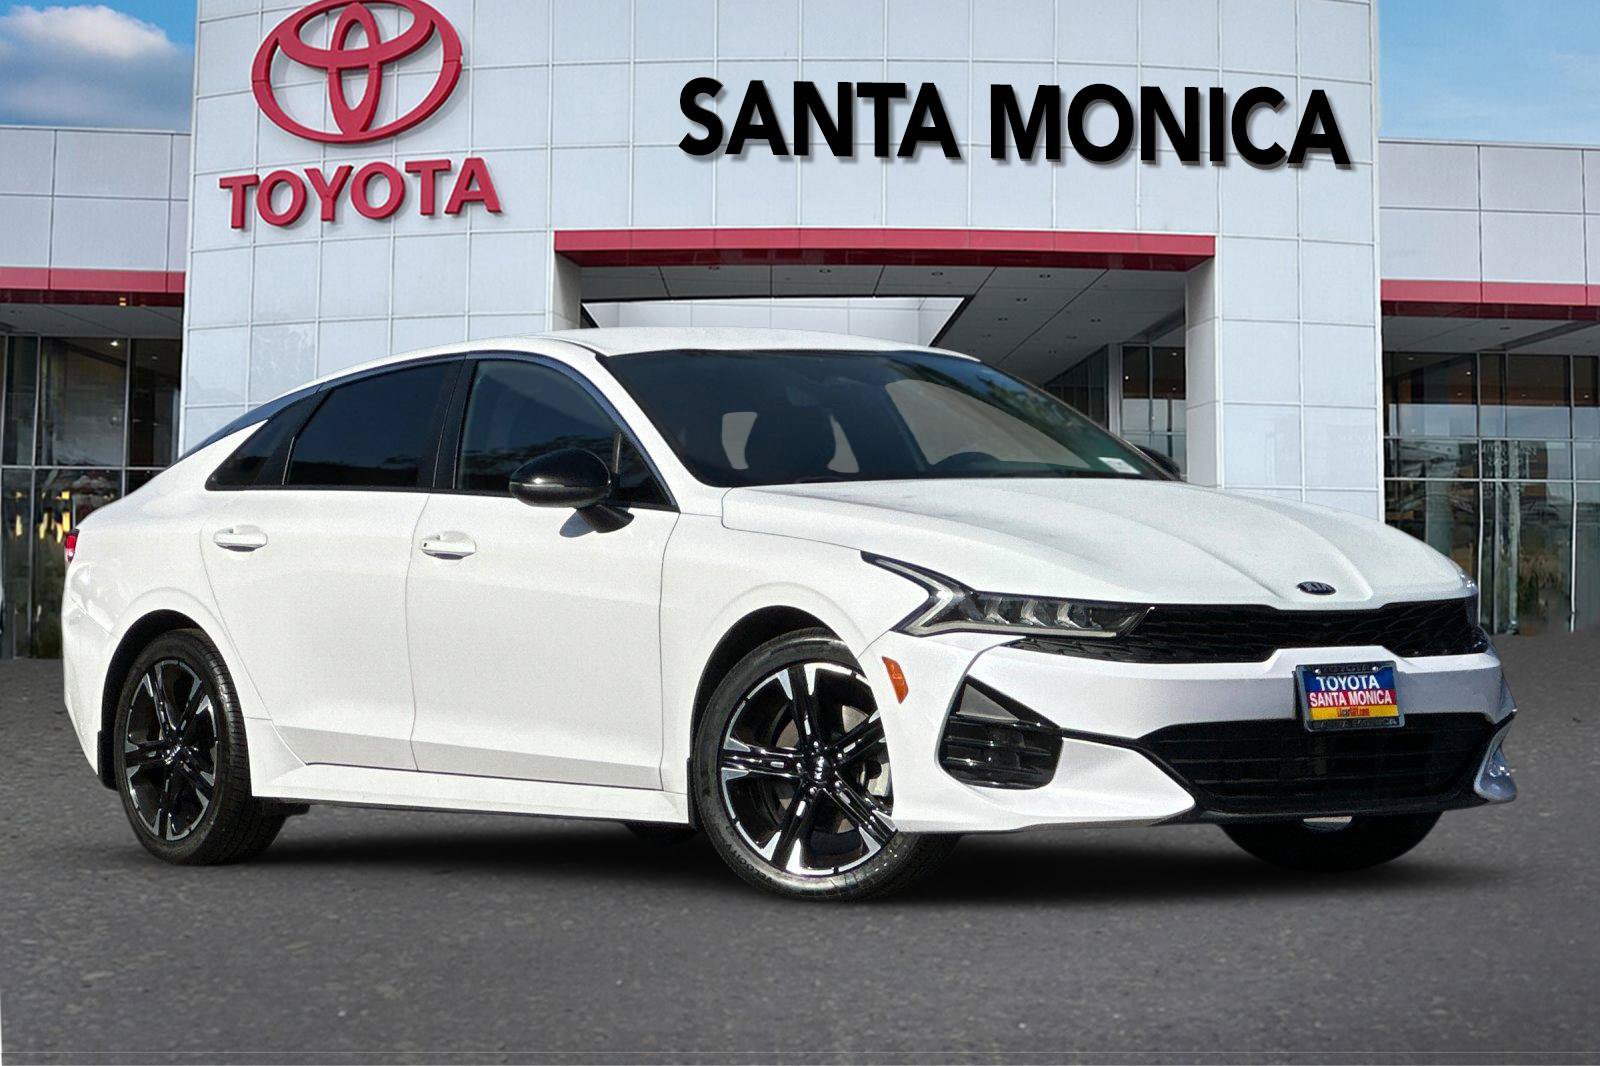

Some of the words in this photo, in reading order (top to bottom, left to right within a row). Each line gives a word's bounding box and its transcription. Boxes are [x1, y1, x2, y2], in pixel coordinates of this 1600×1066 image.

[678, 77, 962, 158] SANTA
[991, 83, 1352, 167] MONICA
[219, 157, 502, 229] TOYOTA
[1299, 580, 1335, 594] KIA
[1316, 674, 1380, 692] TOYOTA
[1309, 692, 1347, 707] SANTA
[1349, 689, 1392, 706] MONICA
